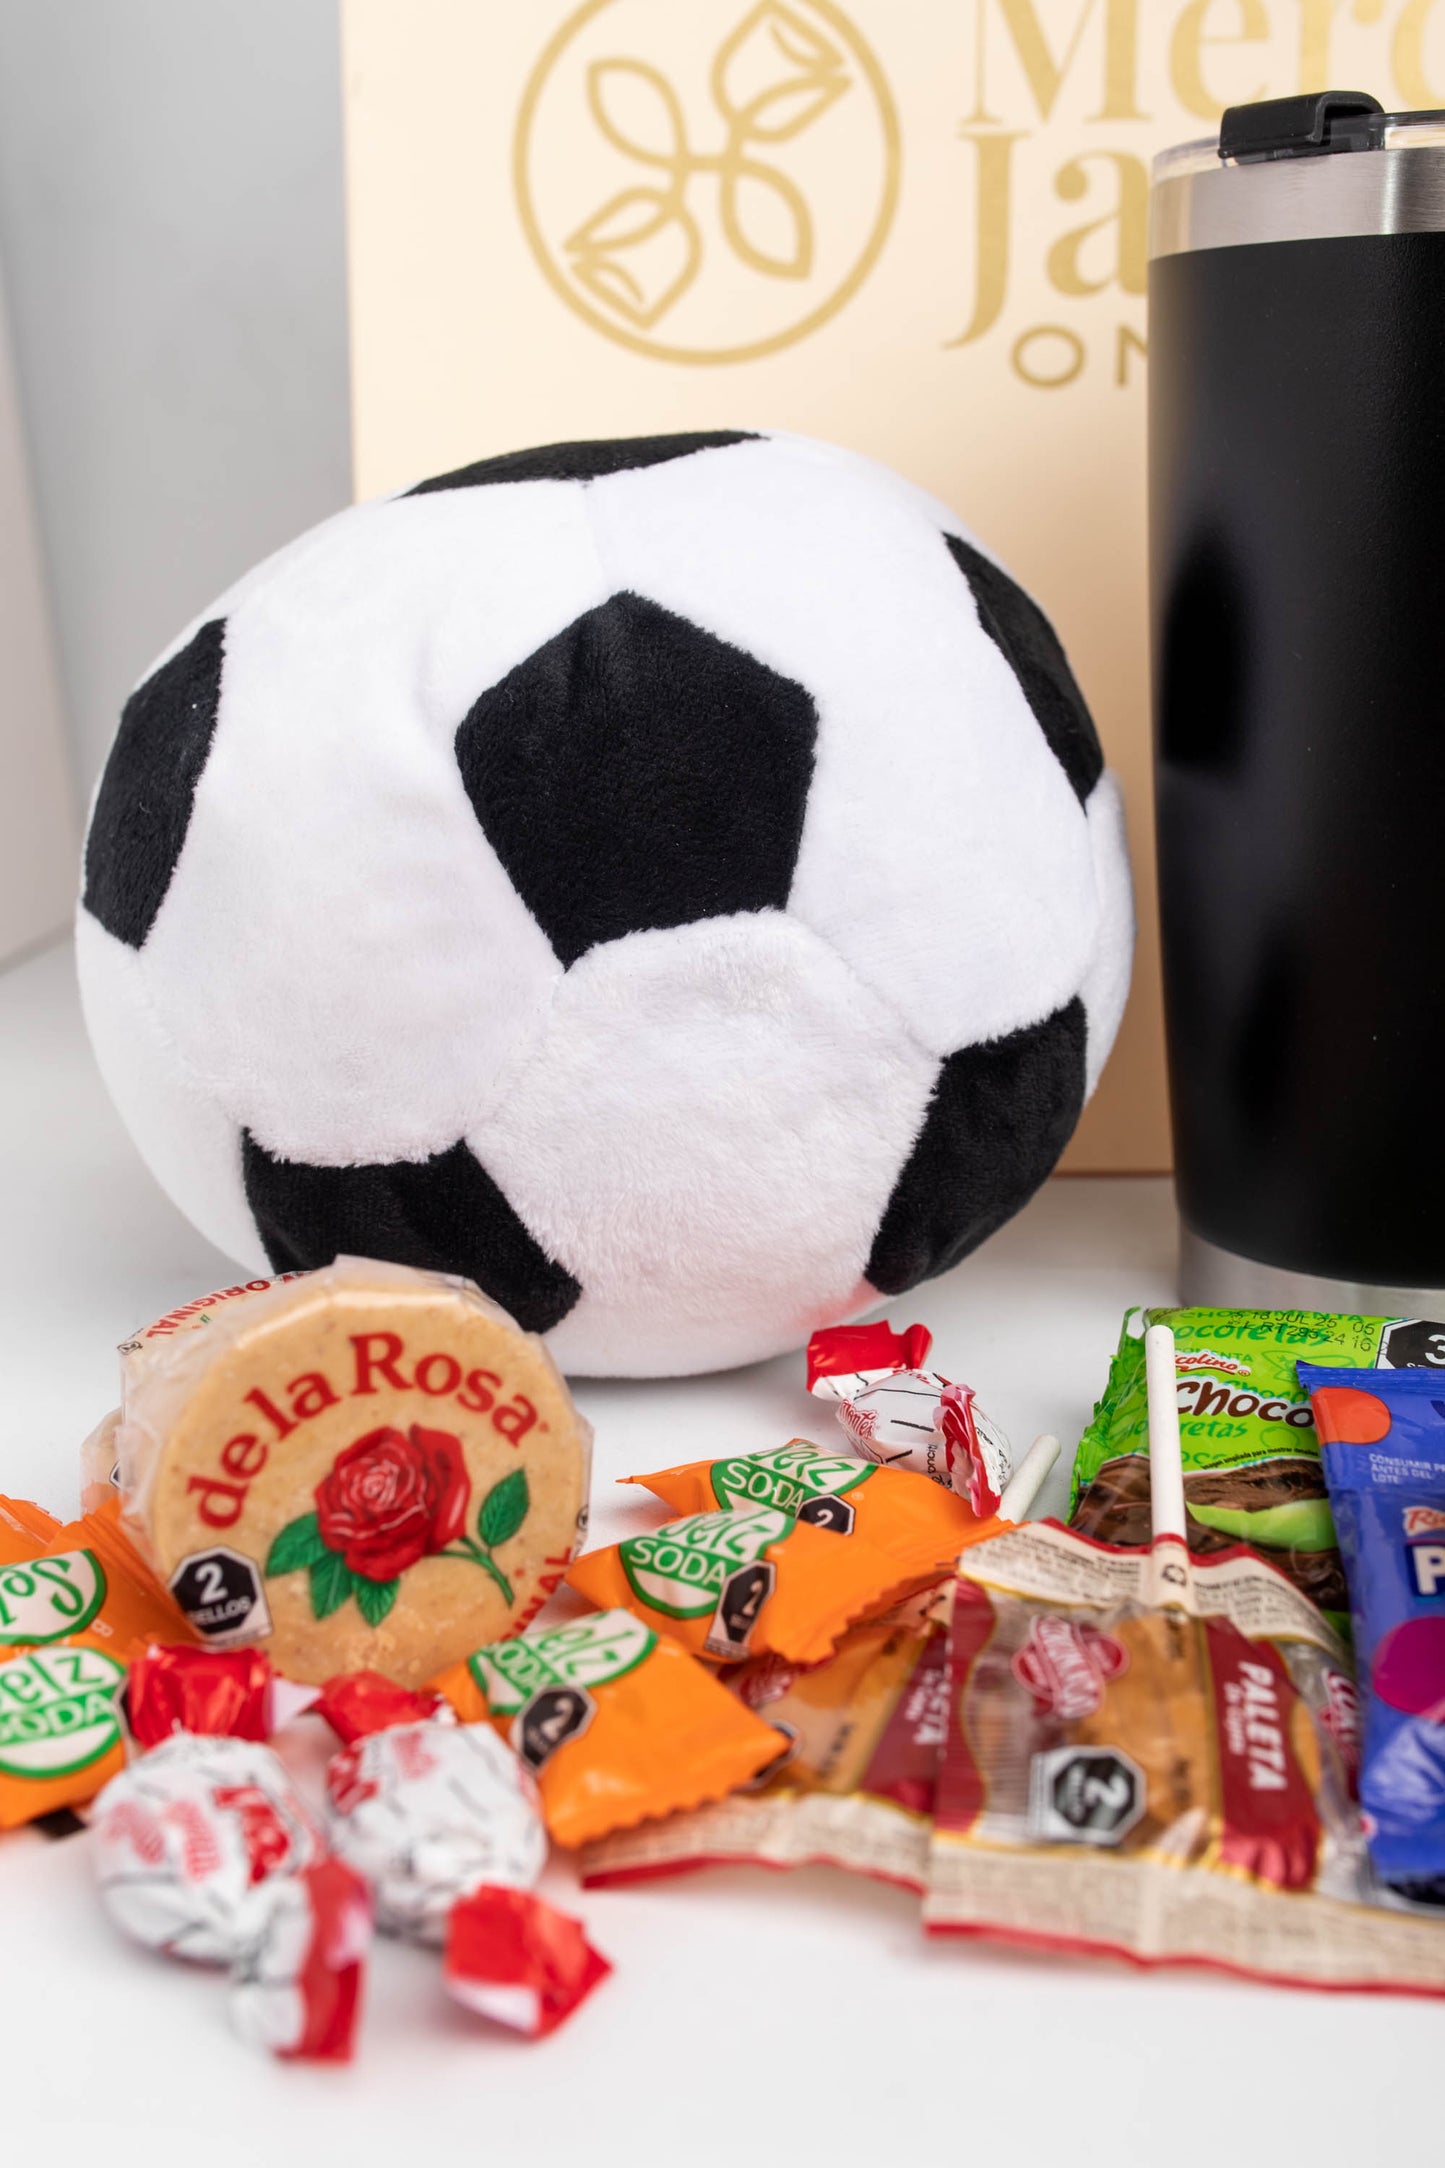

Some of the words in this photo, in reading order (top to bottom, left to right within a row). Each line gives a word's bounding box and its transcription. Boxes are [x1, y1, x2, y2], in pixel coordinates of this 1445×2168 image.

[145, 1279, 271, 1339] ORIGINAL
[1274, 1311, 1310, 1326] JUL
[1314, 1316, 1338, 1329] 25
[1352, 1320, 1375, 1336] 05
[186, 1430, 268, 1531] de
[243, 1369, 341, 1441] la
[348, 1331, 539, 1448] Rosa
[721, 1460, 806, 1514] SODA
[1371, 1462, 1409, 1477] ANTES
[1371, 1472, 1400, 1485] LOTE
[194, 1561, 228, 1604] 2
[628, 1538, 728, 1587] SODA
[540, 1698, 574, 1741] 2
[1236, 1660, 1289, 1791] PALETA
